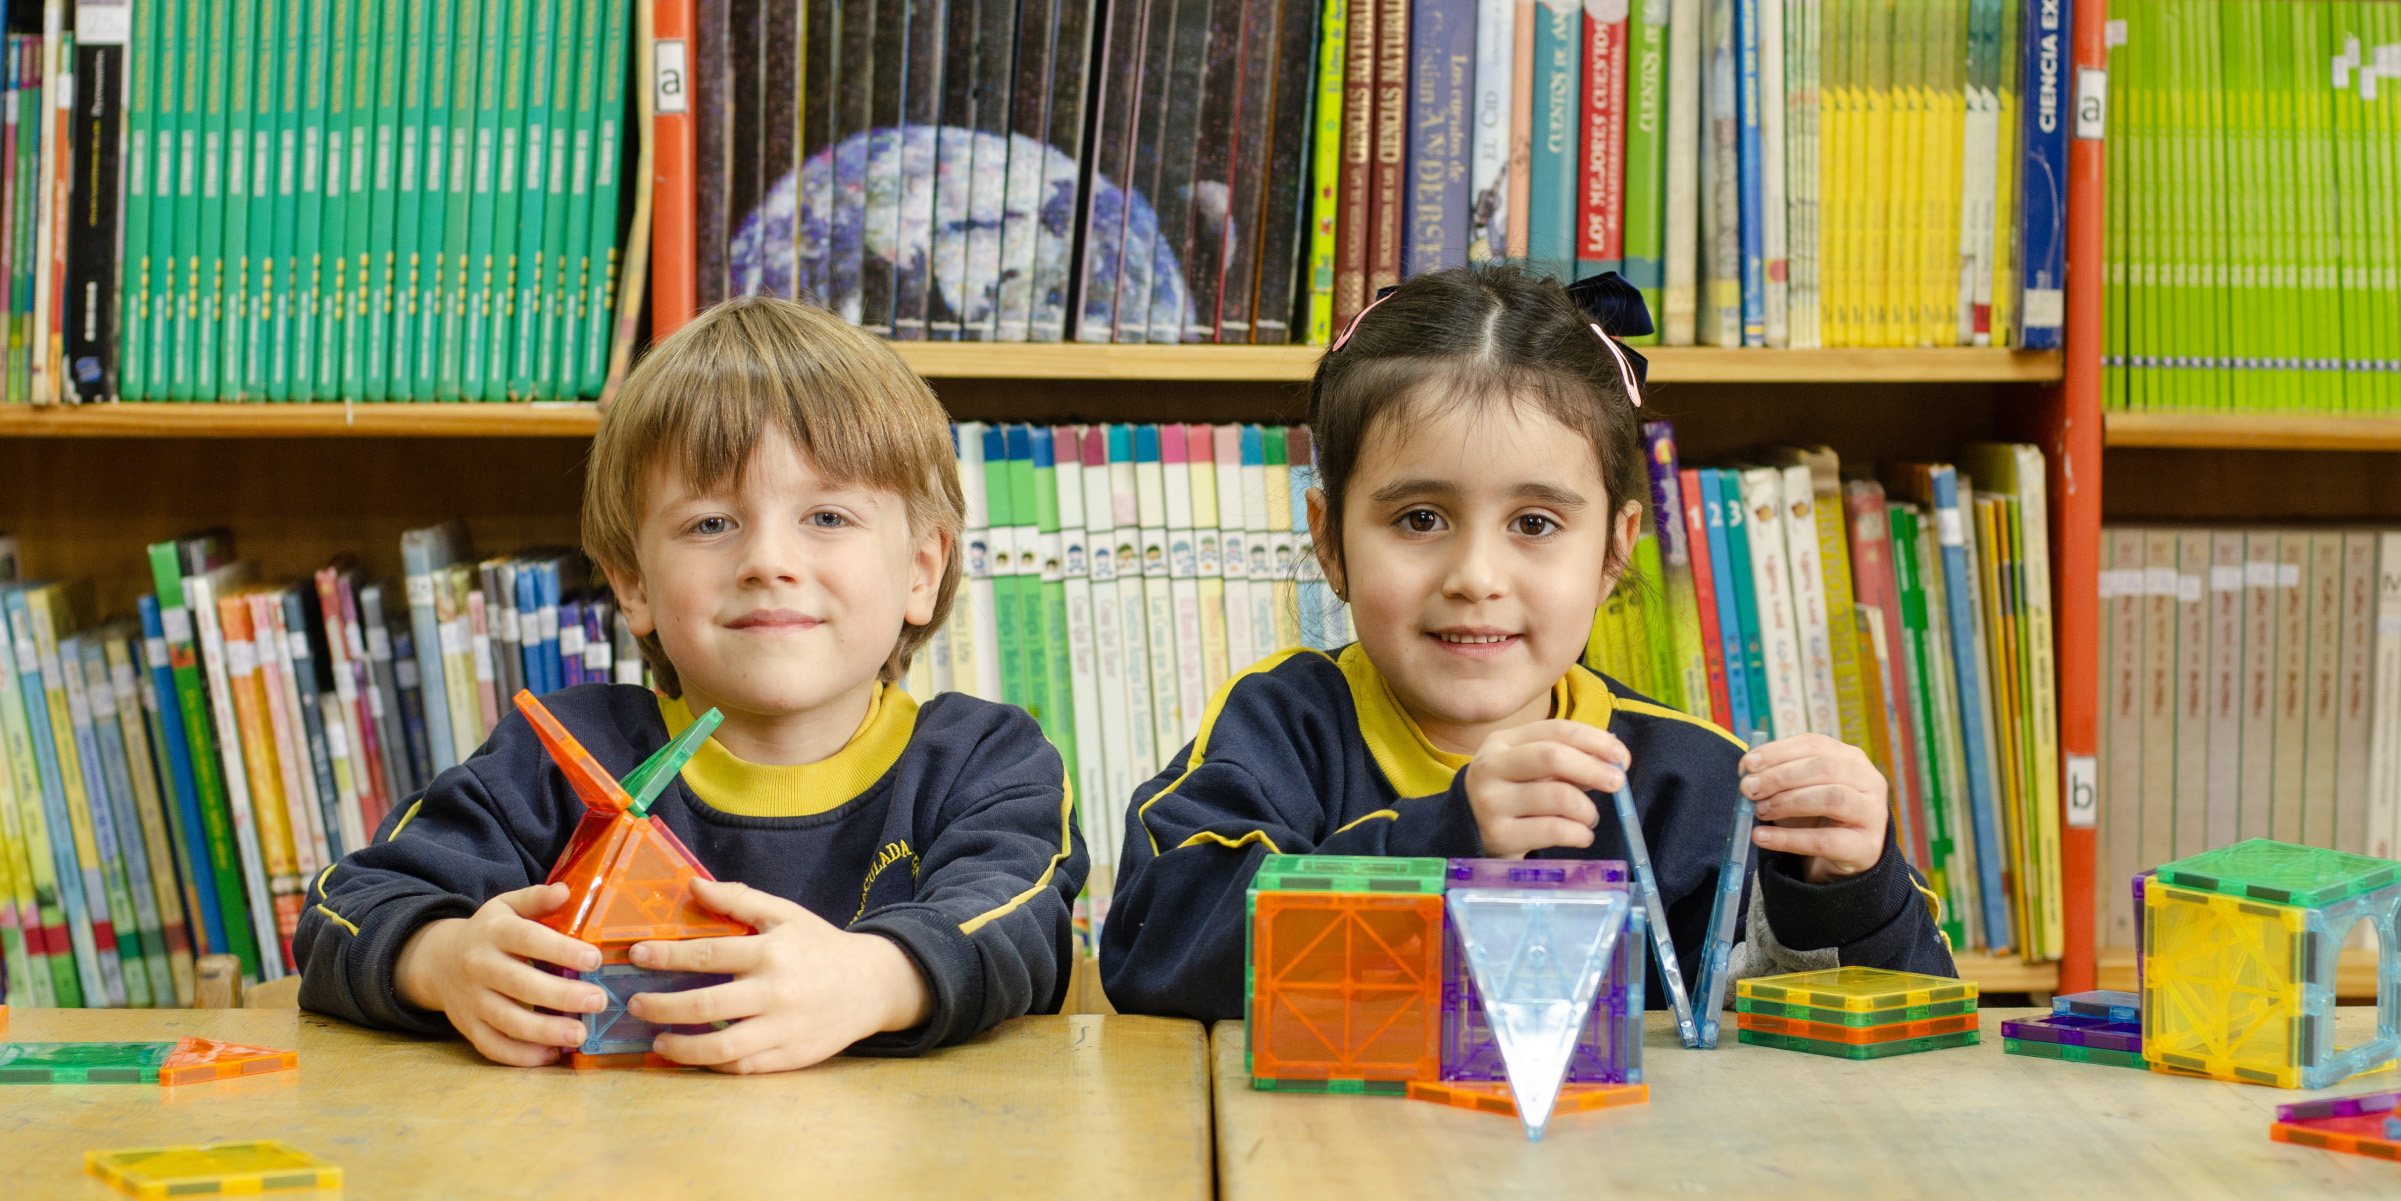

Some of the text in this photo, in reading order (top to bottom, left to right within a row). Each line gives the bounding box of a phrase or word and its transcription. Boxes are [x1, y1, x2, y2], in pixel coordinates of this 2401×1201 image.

[1347, 0, 1373, 83] NATURAL
[1380, 0, 1406, 83] NATURAL
[1449, 54, 1468, 86] Los
[660, 65, 681, 94] a
[1547, 71, 1568, 153] CUENTOS
[1638, 49, 1660, 132] CUENTOS
[2038, 34, 2058, 133] CIENCIA
[2081, 96, 2101, 122] a
[1346, 87, 1371, 164] CIENCIAS
[1377, 87, 1403, 164] CIENCIAS
[1481, 138, 1498, 161] EL
[1588, 20, 1609, 252] LOS MEJORES CUENTOS
[1687, 506, 1702, 530] 1
[1709, 502, 1725, 527] 2
[1729, 501, 1743, 527] 3
[1836, 674, 1863, 749] RIMER
[2072, 773, 2093, 809] b
